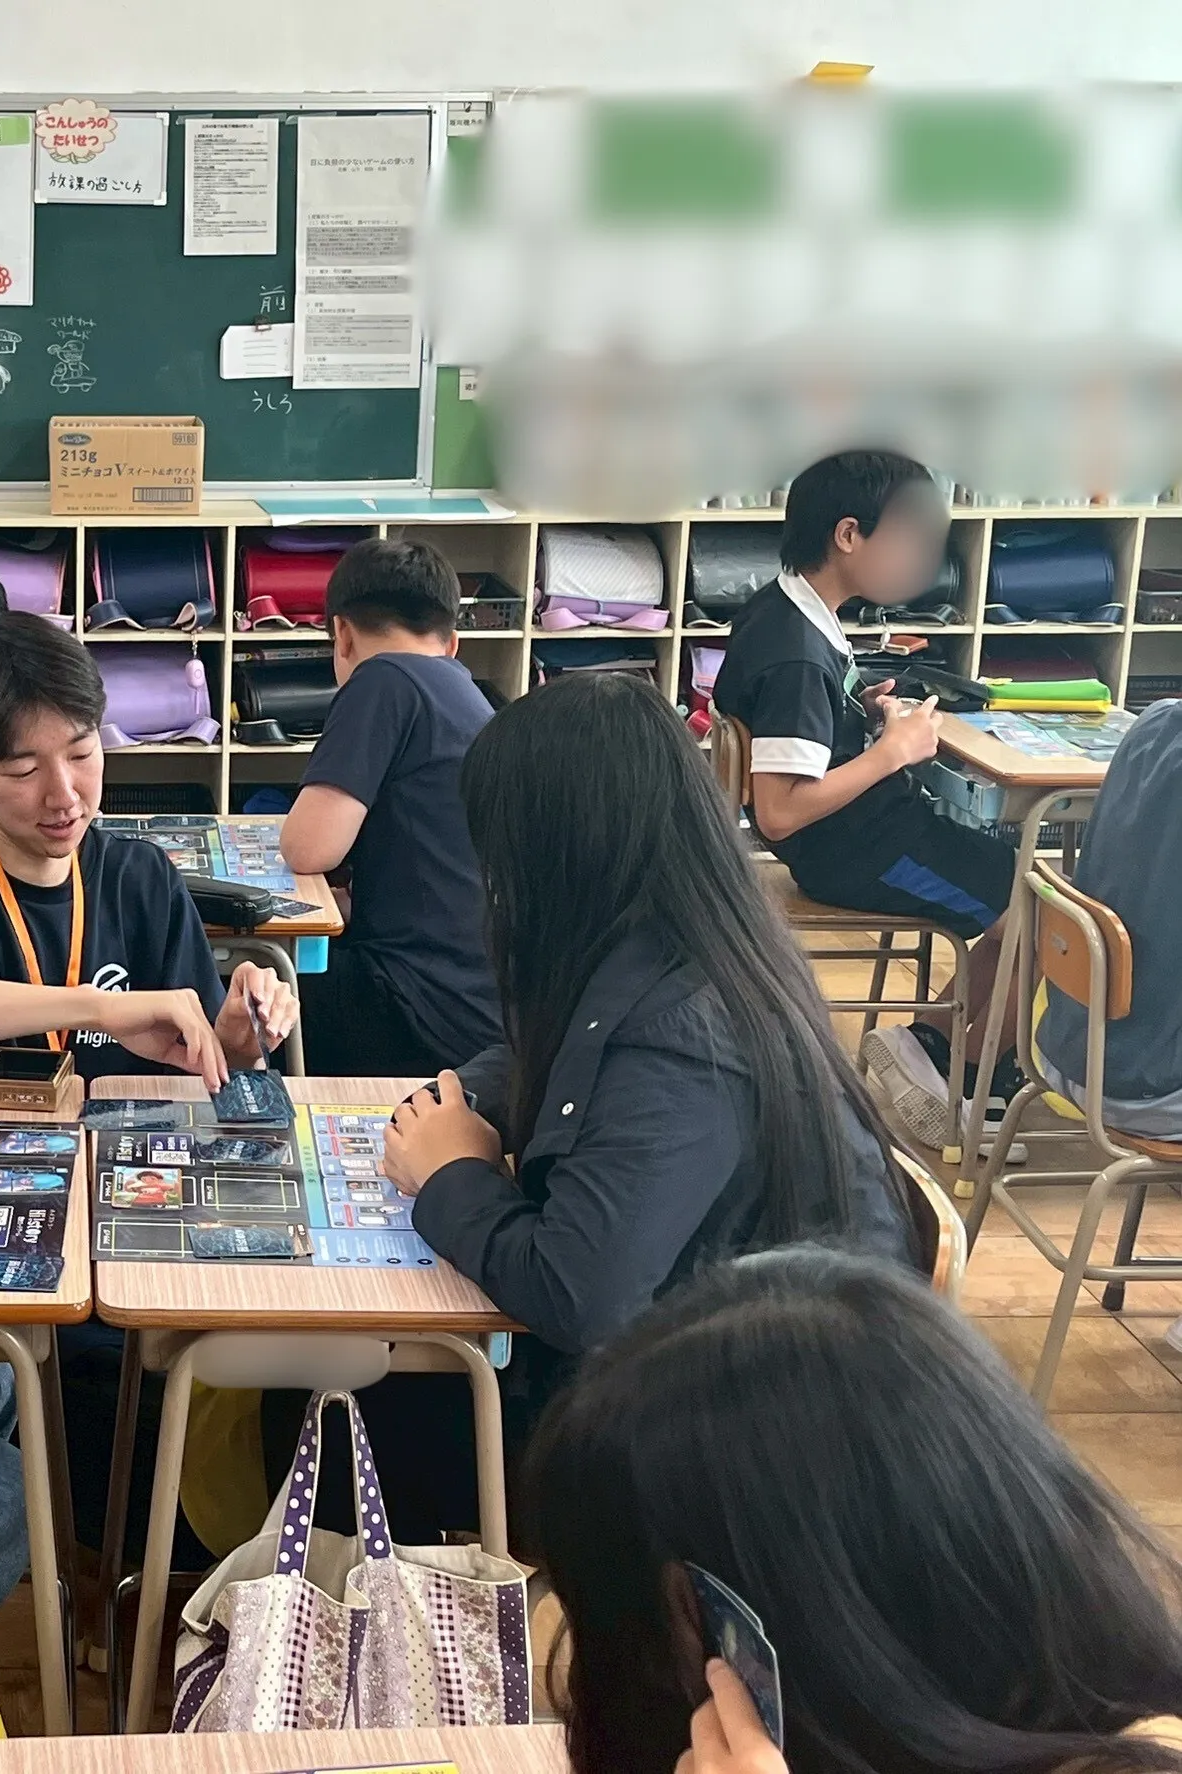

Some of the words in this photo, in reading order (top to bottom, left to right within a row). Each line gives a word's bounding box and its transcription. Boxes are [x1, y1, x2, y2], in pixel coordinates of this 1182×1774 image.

[45, 117, 108, 129] こんしゅうの
[53, 134, 99, 146] たいせつ
[259, 285, 286, 314] 前
[252, 390, 293, 415] うしろ
[60, 449, 98, 463] 213g
